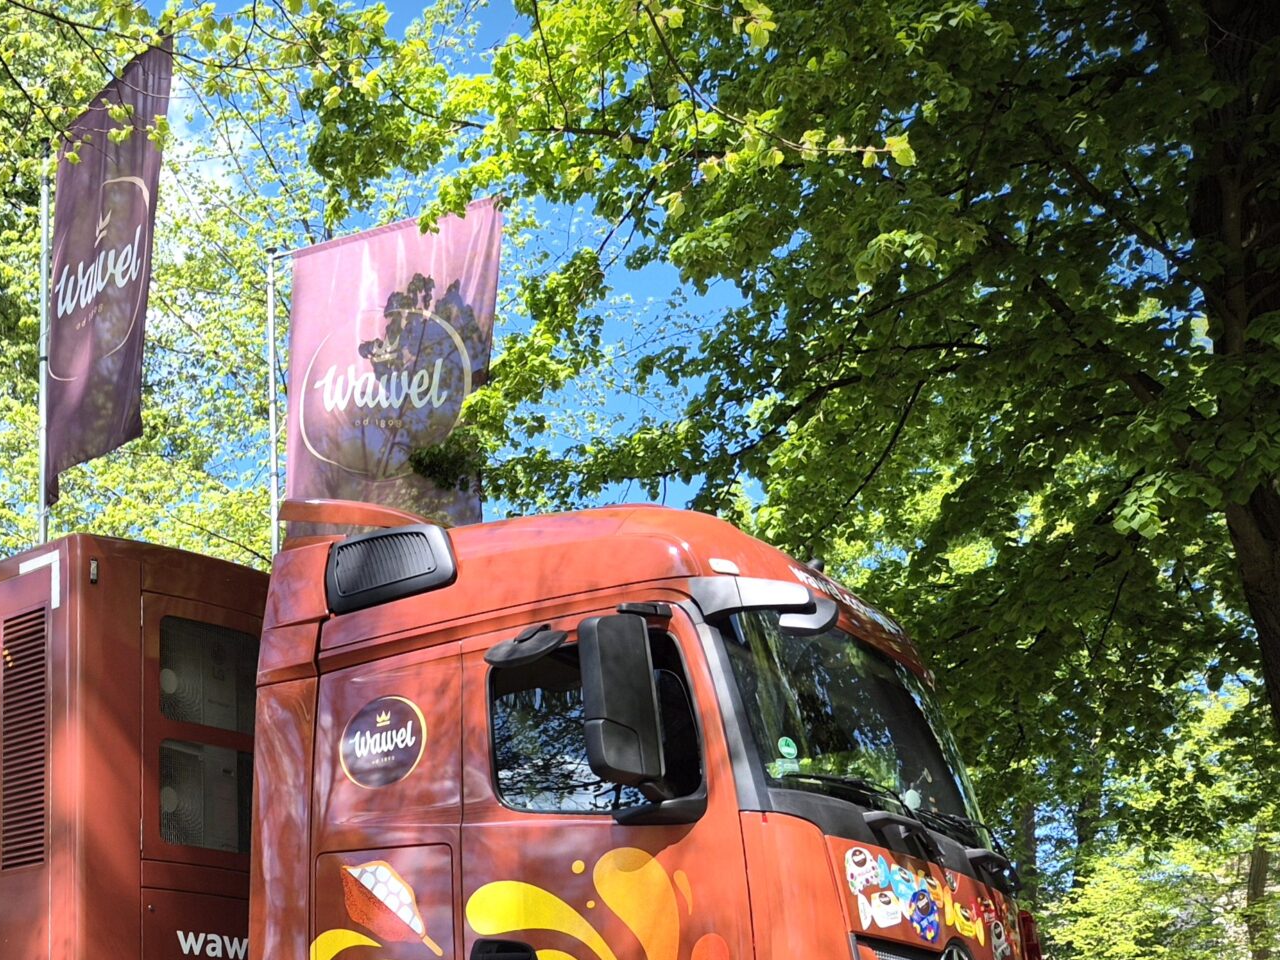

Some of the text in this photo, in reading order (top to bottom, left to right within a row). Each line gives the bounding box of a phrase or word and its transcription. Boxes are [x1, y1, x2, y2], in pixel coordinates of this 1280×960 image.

[55, 224, 141, 319] Wawel
[314, 358, 447, 412] Wawel
[349, 720, 416, 758] Wawel
